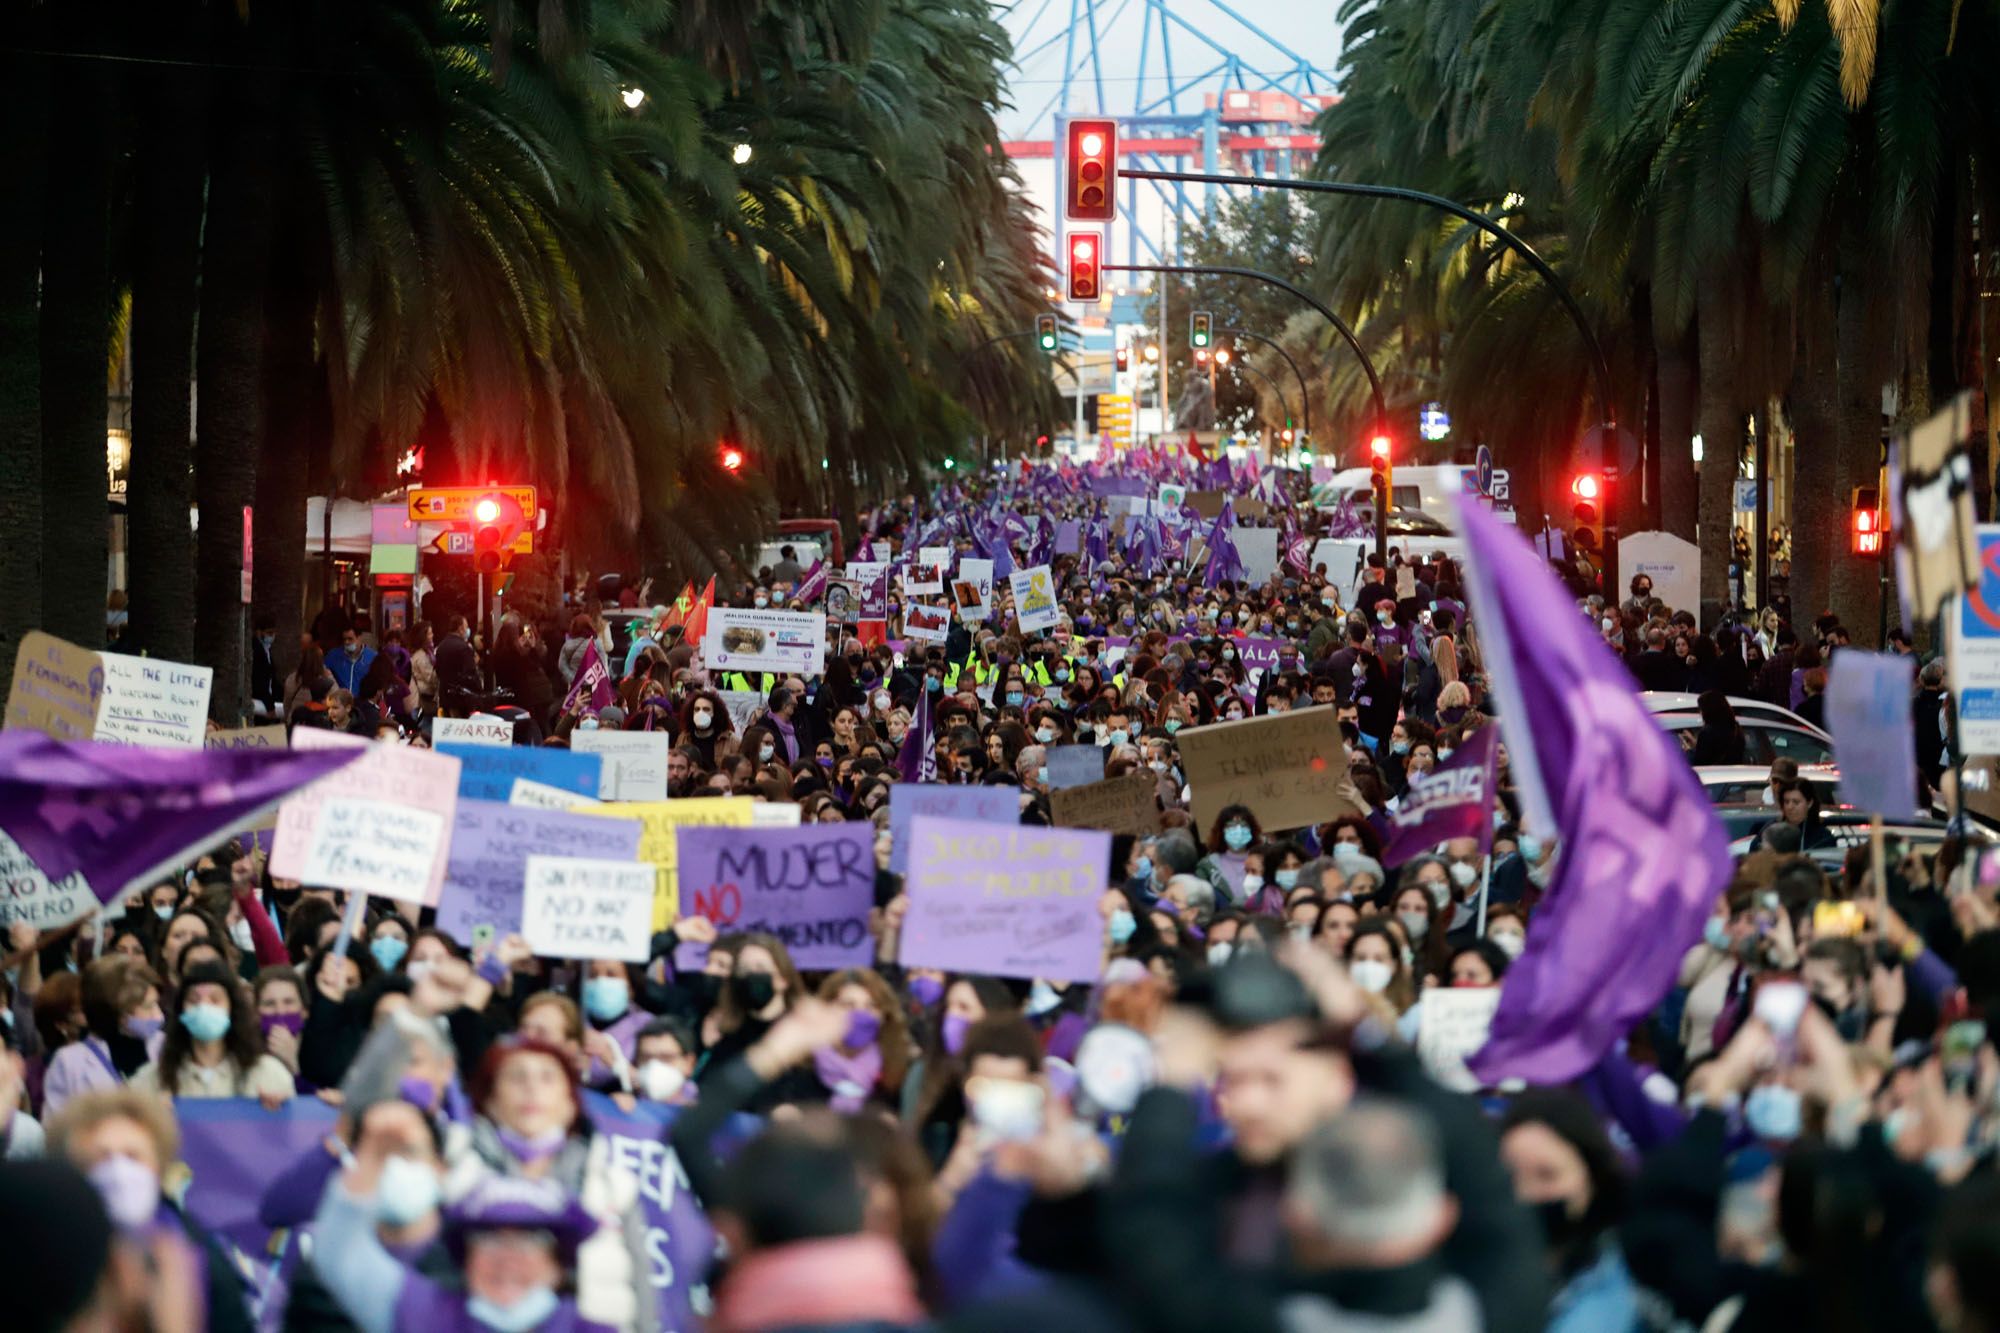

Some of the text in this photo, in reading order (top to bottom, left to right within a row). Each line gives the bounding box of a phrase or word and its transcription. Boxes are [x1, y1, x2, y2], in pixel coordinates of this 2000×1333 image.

[110, 664, 207, 688] ALL THE LITTLE
[717, 838, 873, 892] MUJER
[541, 896, 586, 918] NO
[694, 882, 743, 925] NO
